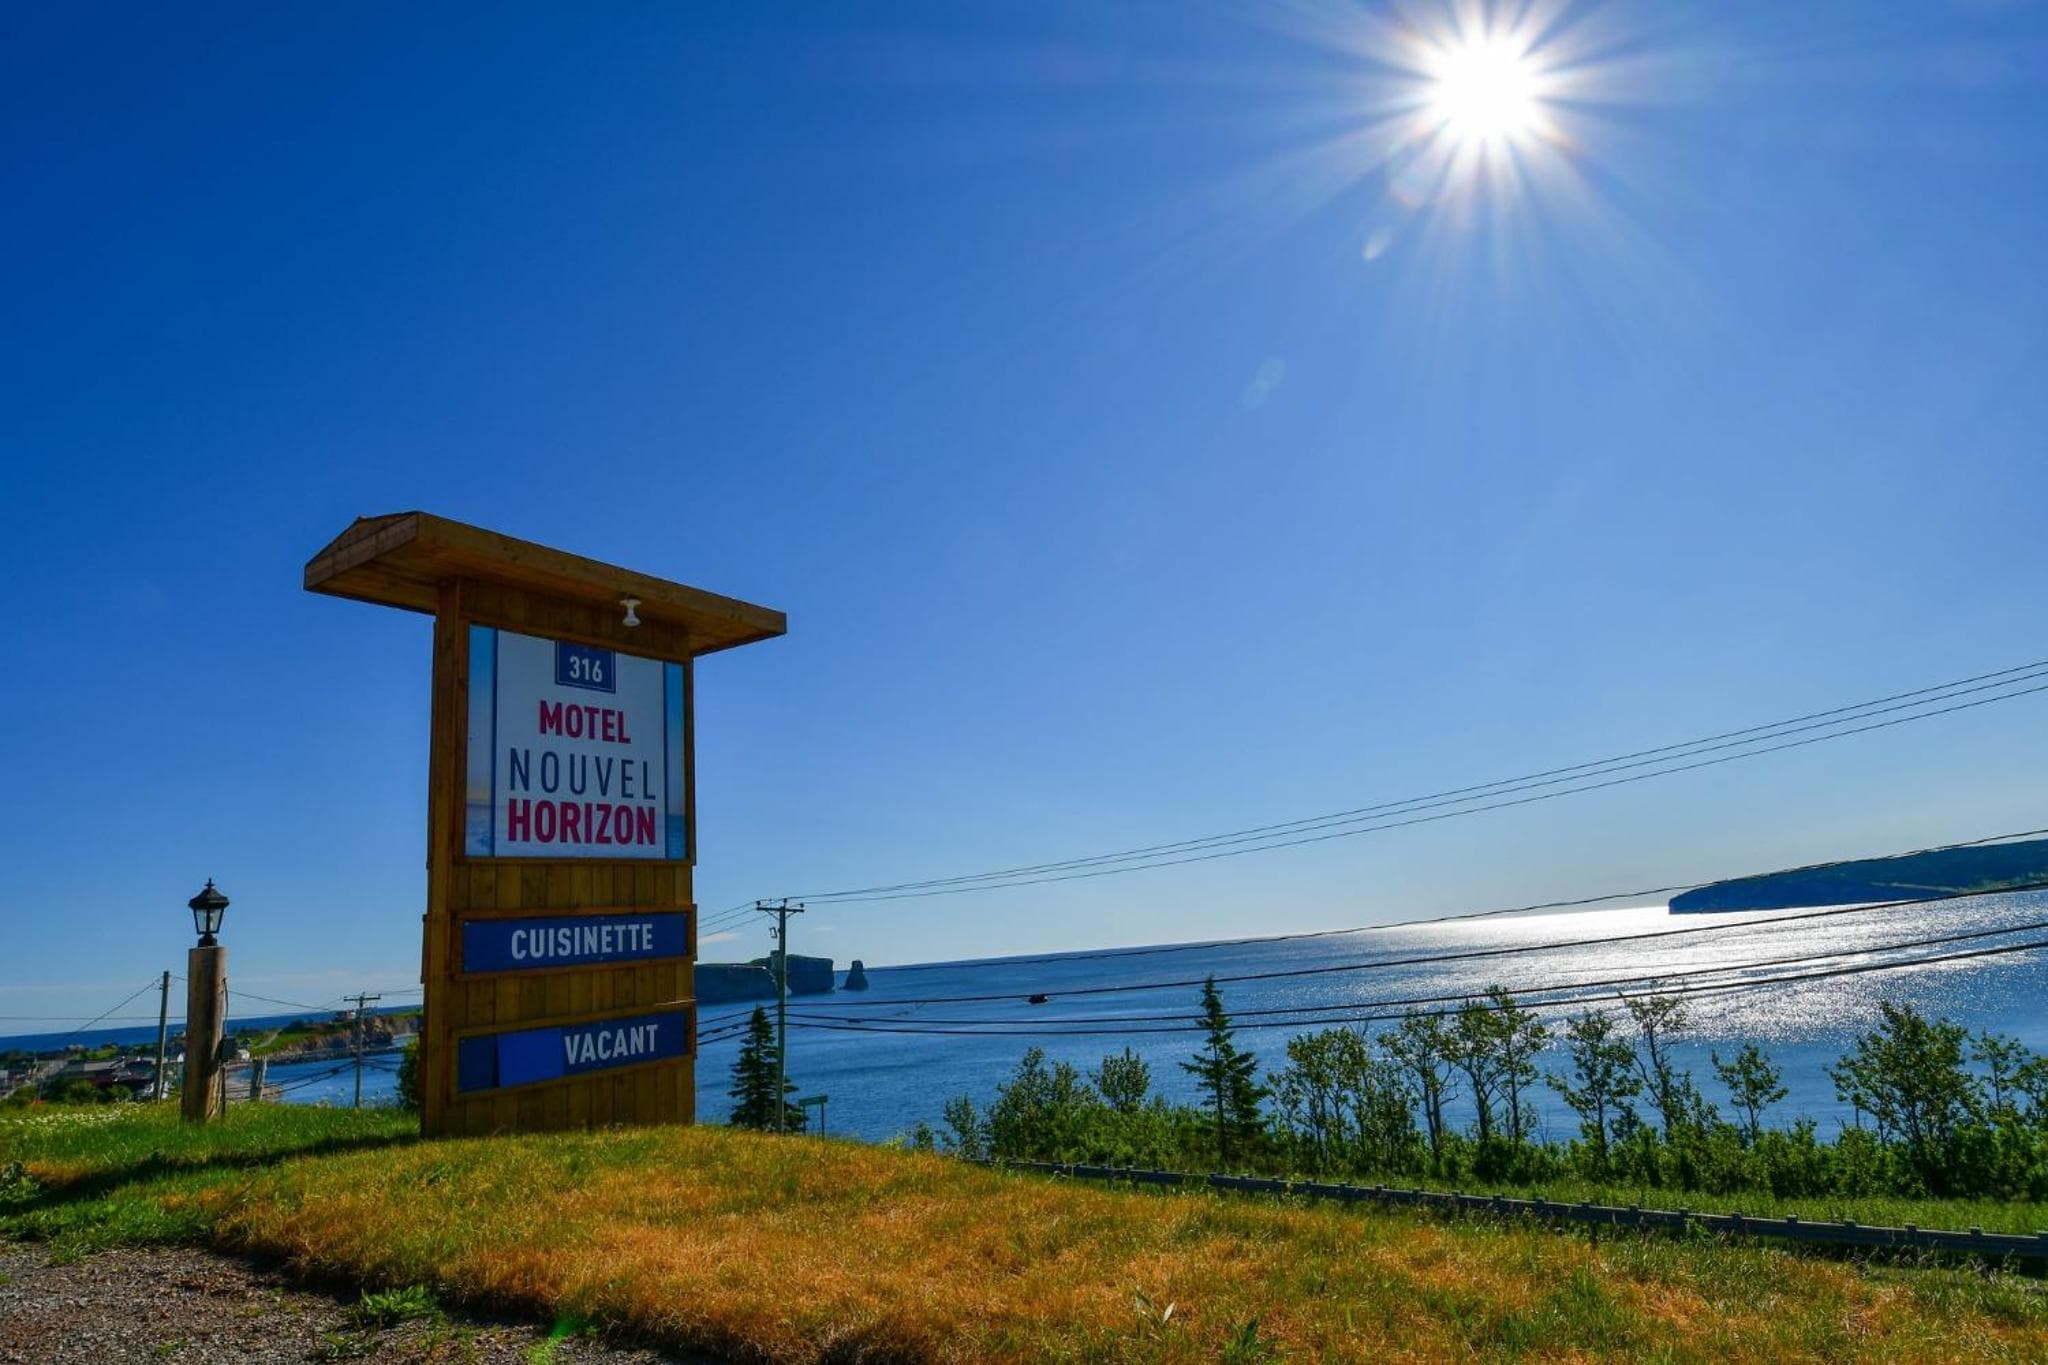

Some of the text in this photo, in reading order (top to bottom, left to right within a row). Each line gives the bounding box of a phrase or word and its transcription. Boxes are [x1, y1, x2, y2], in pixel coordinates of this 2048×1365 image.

[569, 656, 603, 683] 316
[539, 700, 631, 744] MOTEL
[510, 748, 656, 800] NOUVEL
[507, 798, 656, 845] HORIZON
[511, 923, 653, 960] CUISINETTE
[564, 1024, 659, 1065] VACANT
